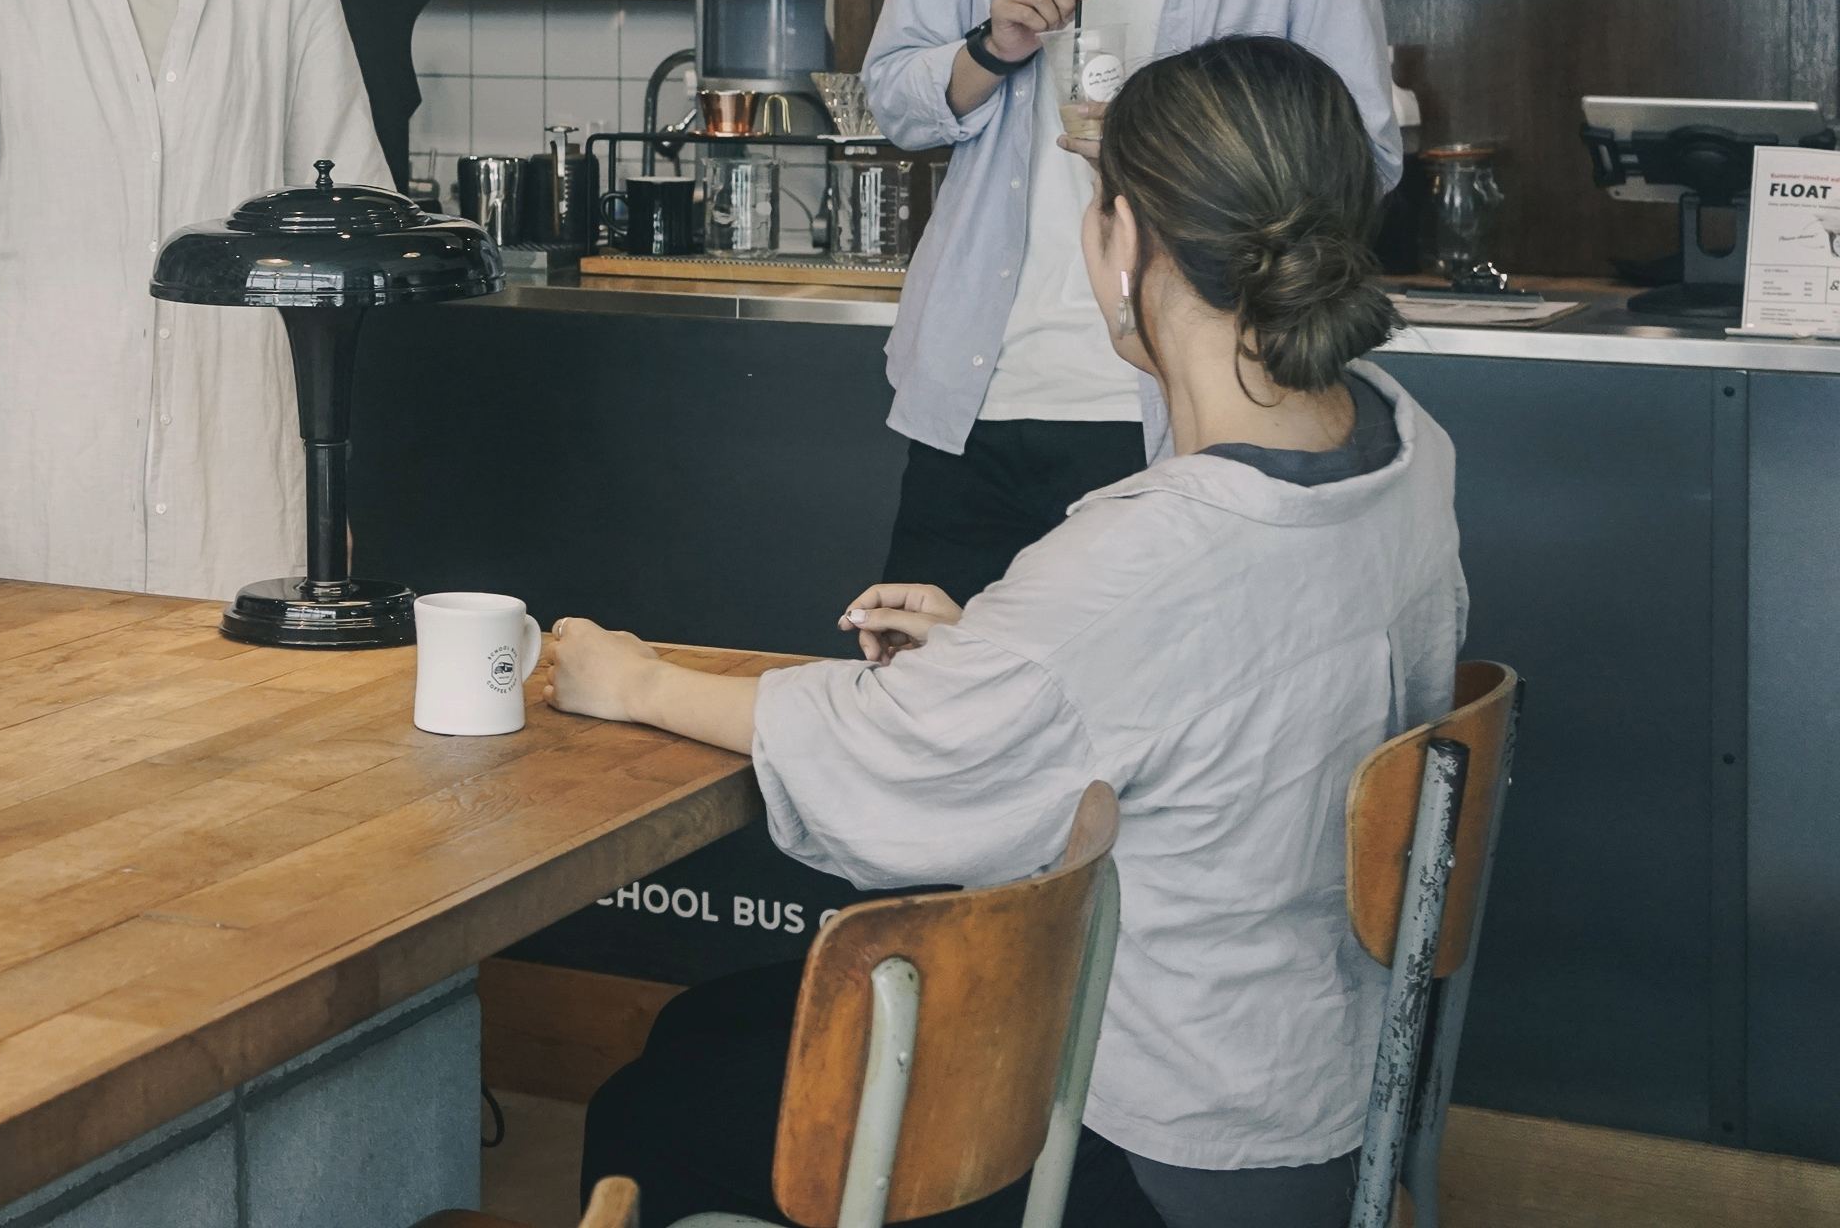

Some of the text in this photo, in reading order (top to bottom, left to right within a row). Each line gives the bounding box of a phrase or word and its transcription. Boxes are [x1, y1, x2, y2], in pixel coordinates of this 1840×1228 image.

[1769, 183, 1832, 199] FLOAT
[597, 882, 719, 922] HOOL
[734, 896, 805, 934] BUS
